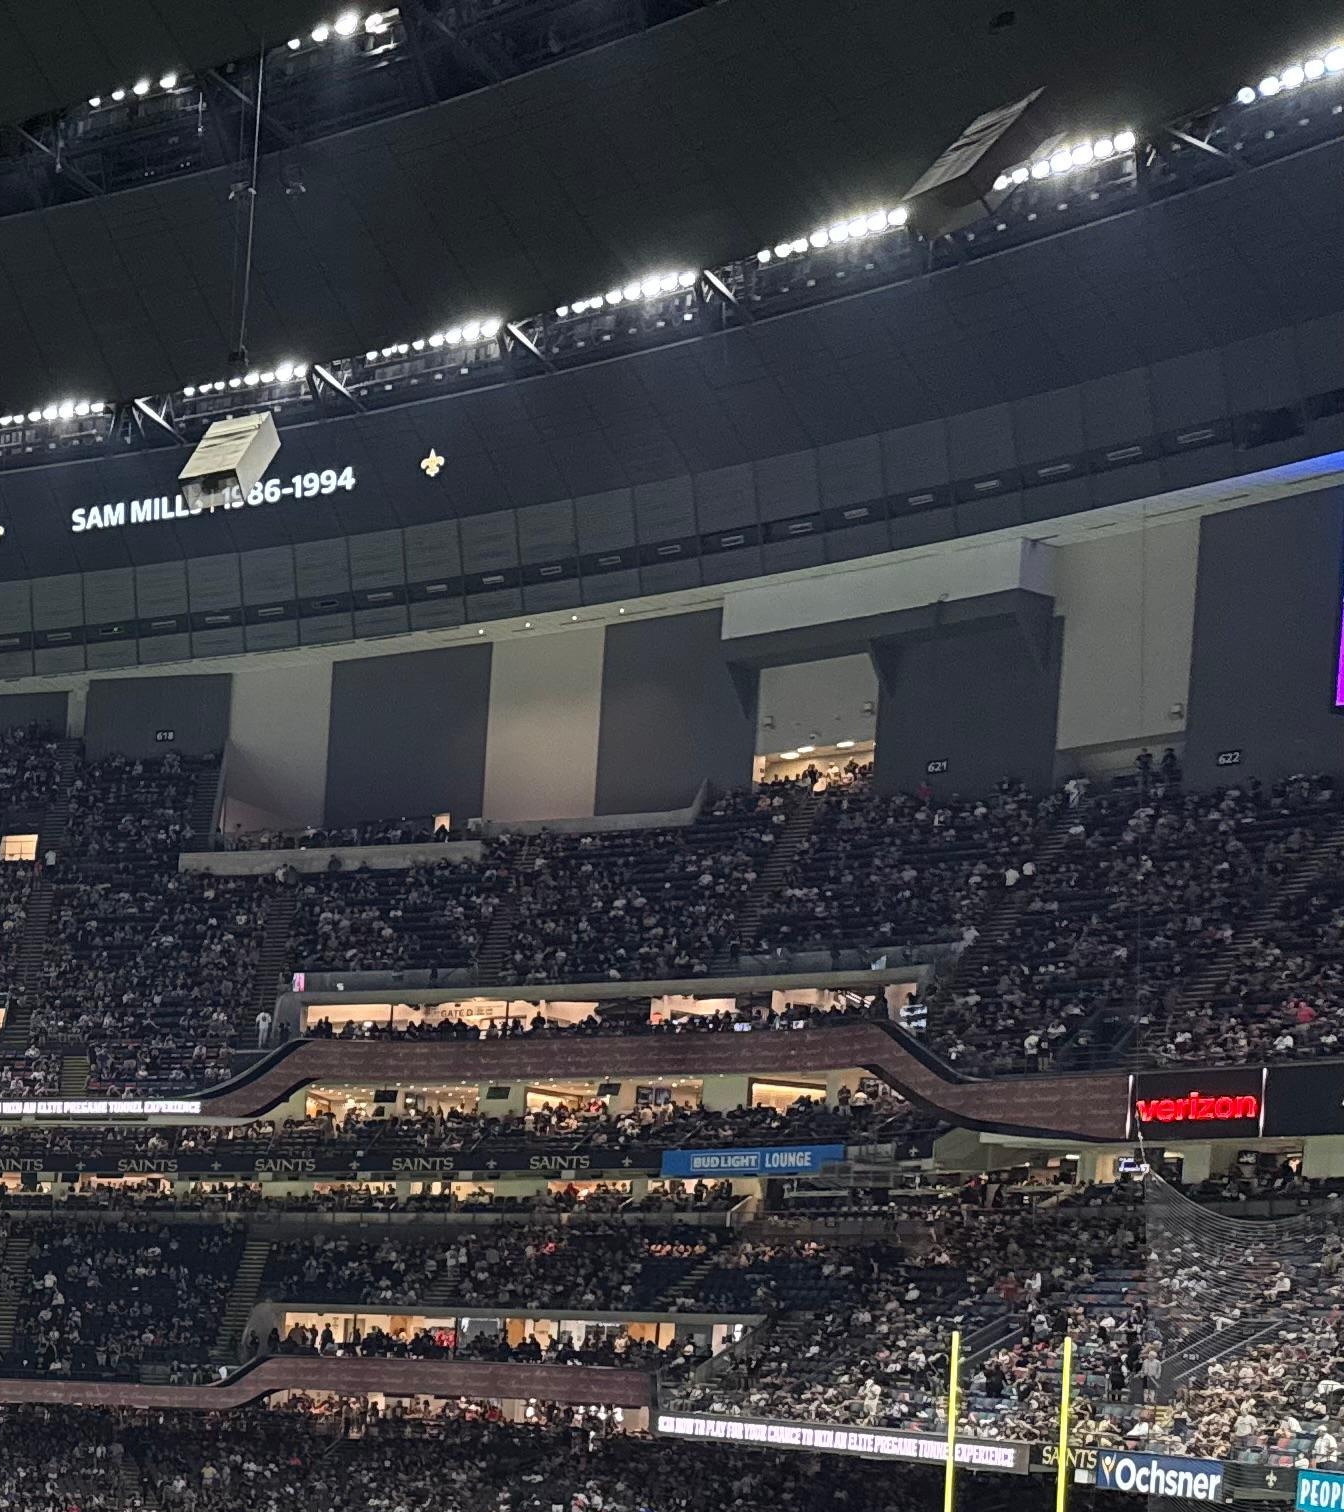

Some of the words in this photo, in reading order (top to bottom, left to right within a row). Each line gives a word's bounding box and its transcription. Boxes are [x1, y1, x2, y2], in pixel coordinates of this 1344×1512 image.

[71, 502, 125, 533] SAM
[156, 731, 174, 740] 618
[1136, 1091, 1258, 1122] verizon
[117, 1158, 178, 1173] SAINTS
[392, 1157, 453, 1172] SAINTS
[529, 1155, 591, 1171] SAINTS
[693, 1155, 719, 1169] BUD
[720, 1154, 758, 1169] LIGHT
[764, 1152, 812, 1169] LOUNGE
[1042, 1446, 1098, 1470] SANTS
[1115, 1456, 1222, 1501] Ochsner
[1300, 1478, 1344, 1510] PEOP
